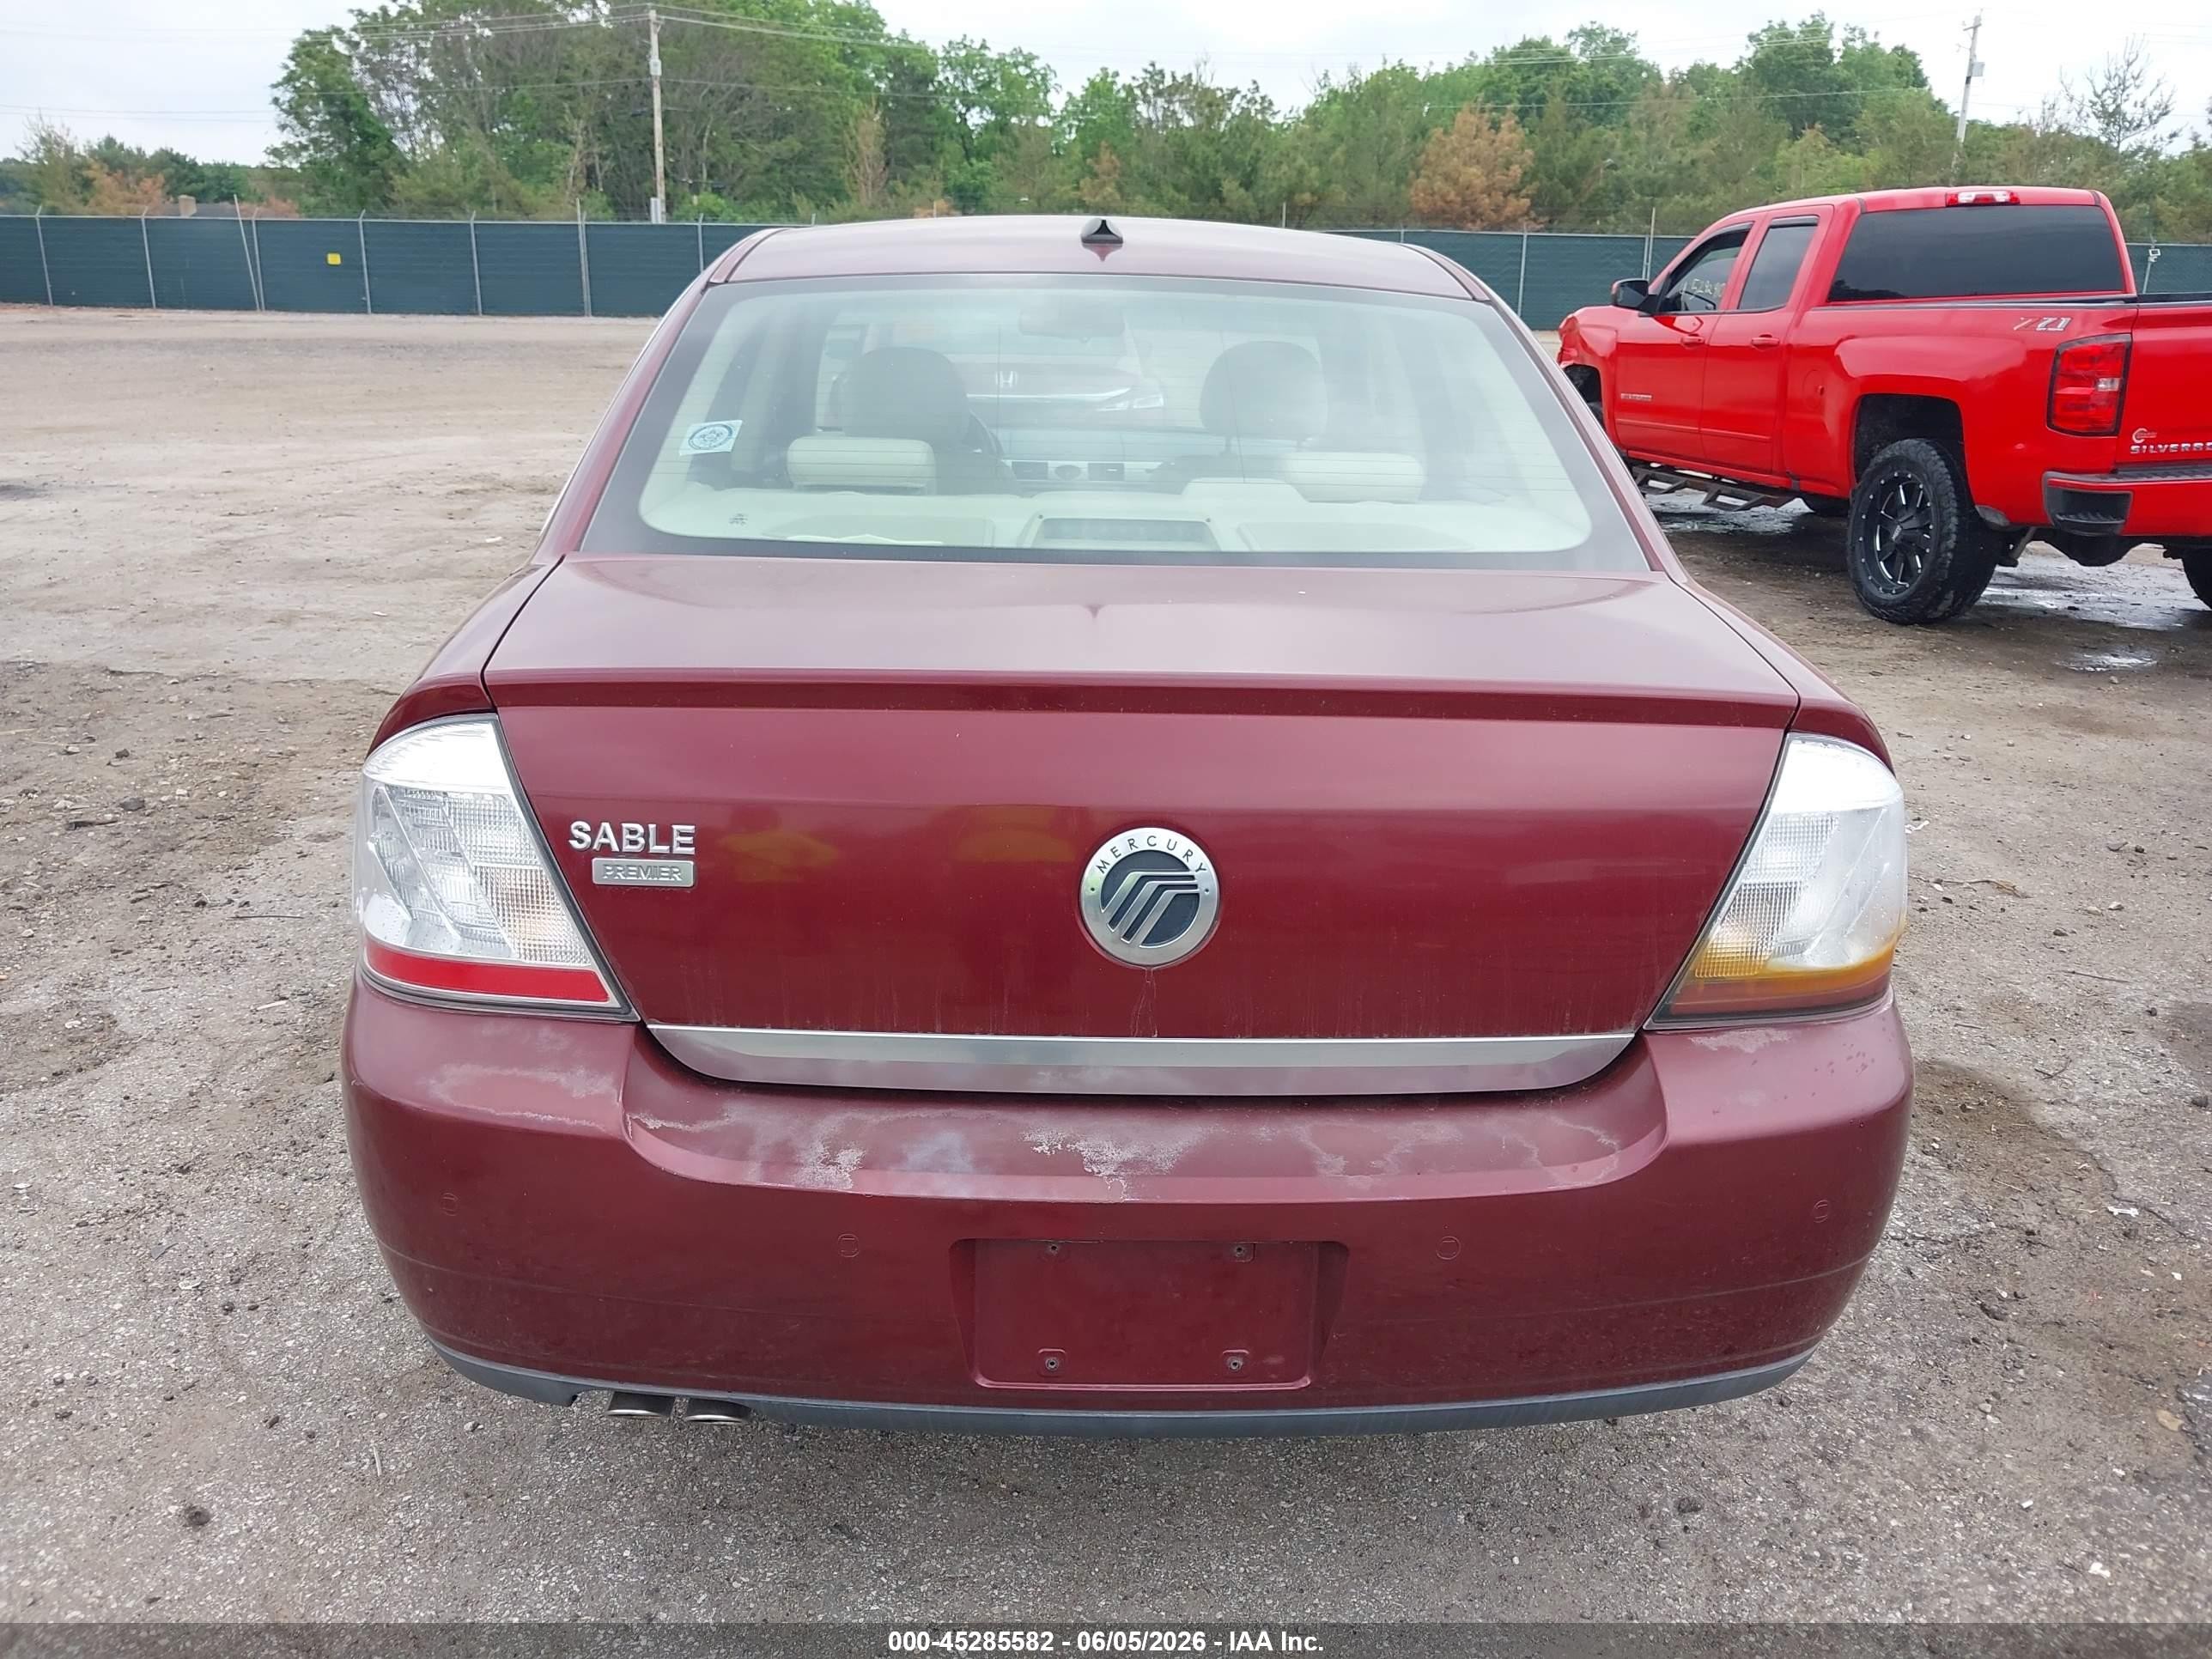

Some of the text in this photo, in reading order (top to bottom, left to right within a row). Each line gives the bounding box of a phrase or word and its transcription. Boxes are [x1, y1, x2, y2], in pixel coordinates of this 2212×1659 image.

[568, 820, 696, 855] SABLE
[1096, 835, 1207, 874] MERCURY
[603, 864, 684, 882] PREMIER
